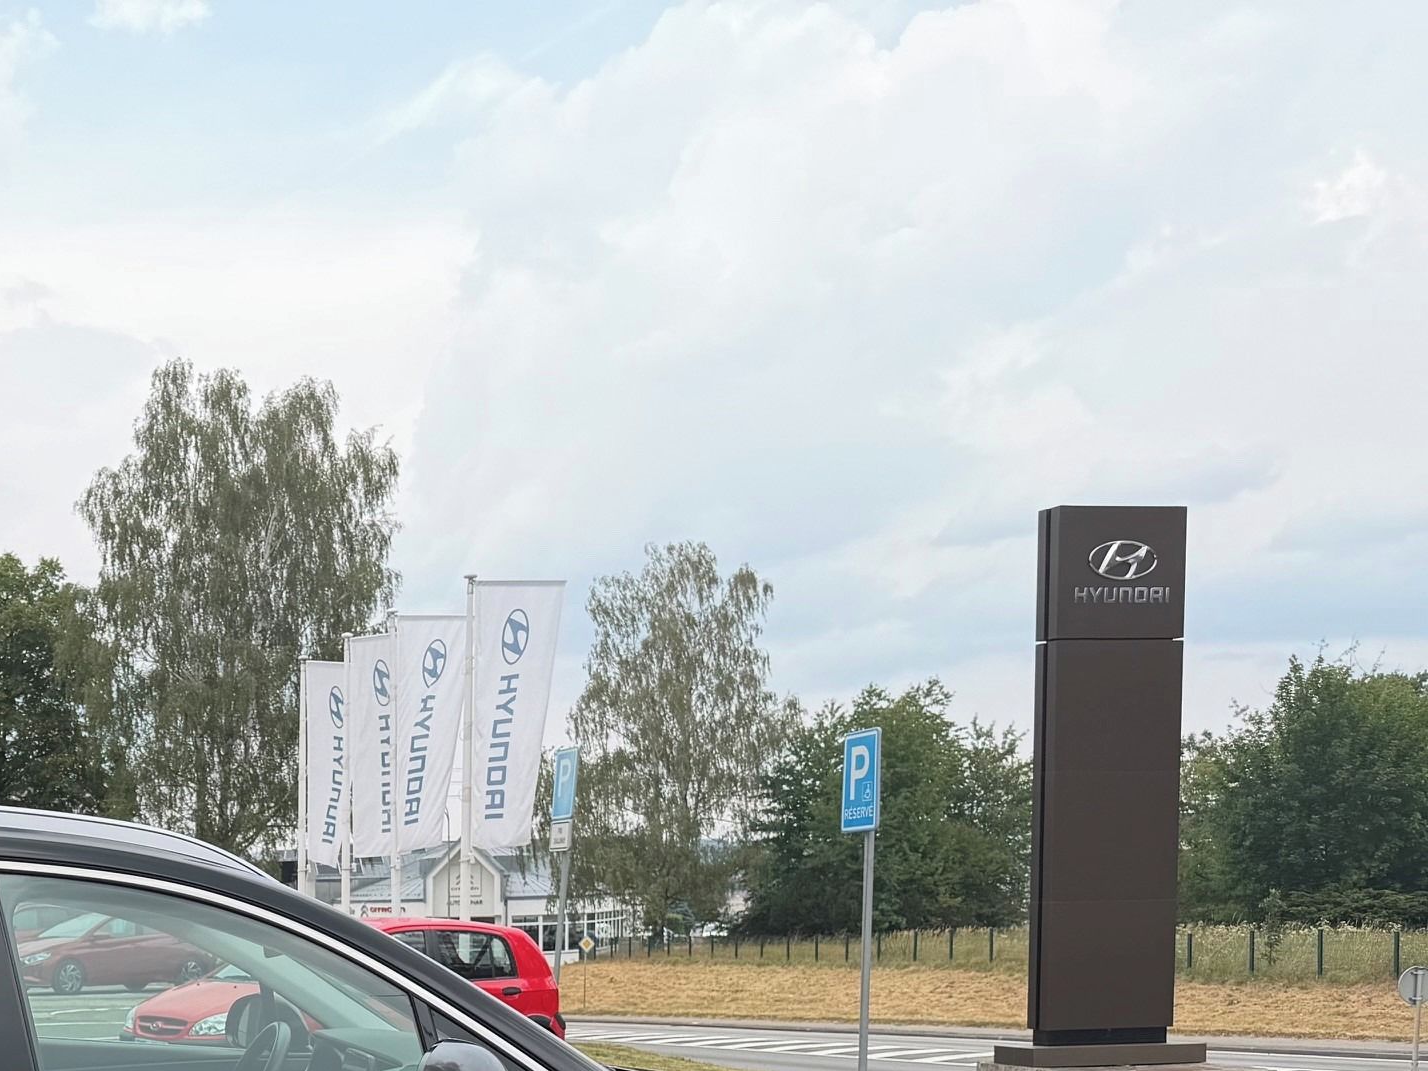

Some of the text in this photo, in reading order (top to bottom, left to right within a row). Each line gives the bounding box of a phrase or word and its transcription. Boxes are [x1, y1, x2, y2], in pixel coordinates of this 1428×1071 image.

[1074, 586, 1170, 603] HYUNDAI
[404, 694, 436, 826] HYUNDAI
[484, 674, 519, 820] HYUNDAI
[557, 758, 572, 798] P
[849, 745, 870, 801] P
[322, 736, 343, 844] HYUNDAI
